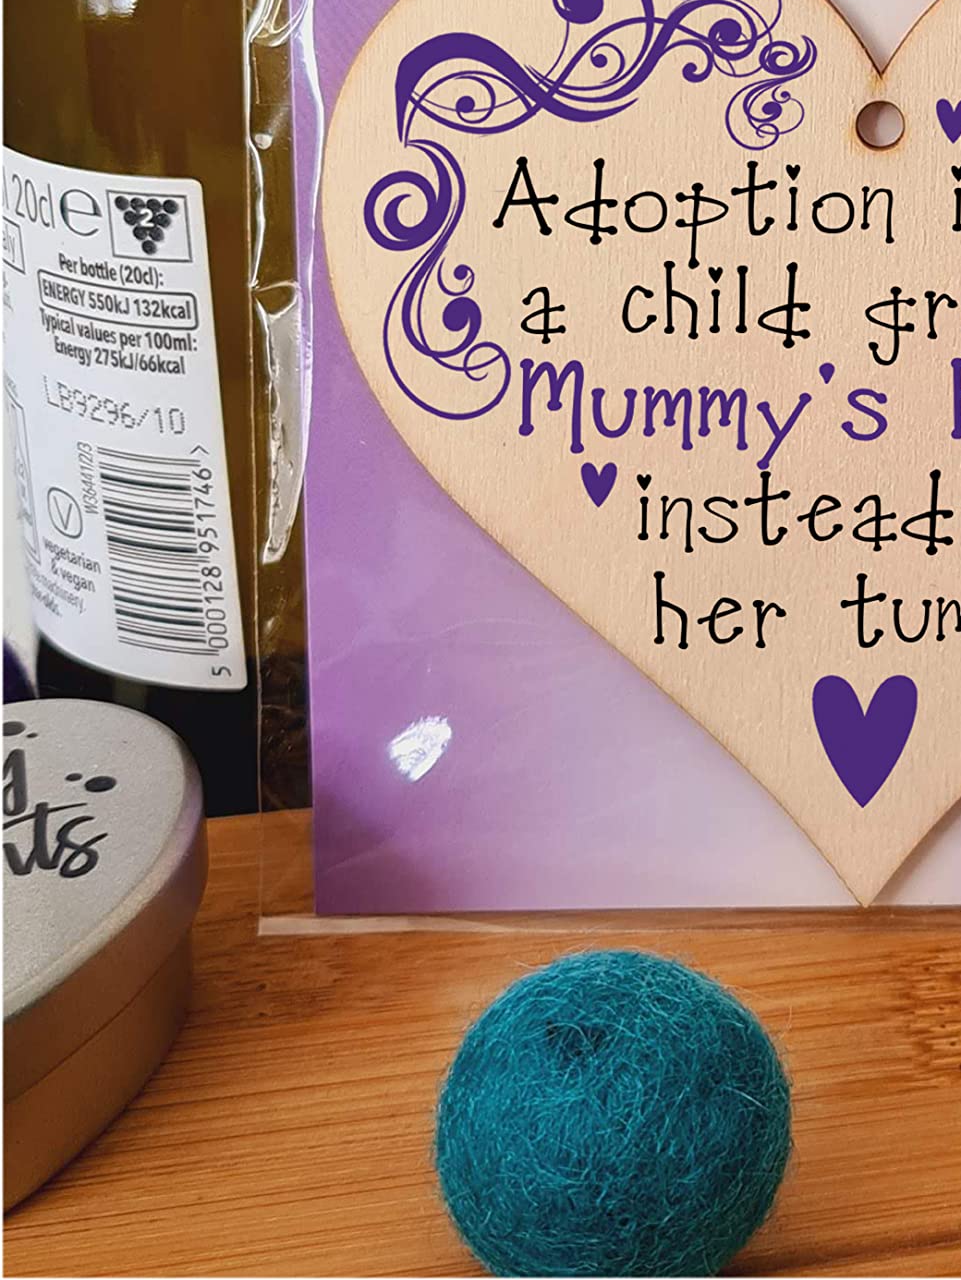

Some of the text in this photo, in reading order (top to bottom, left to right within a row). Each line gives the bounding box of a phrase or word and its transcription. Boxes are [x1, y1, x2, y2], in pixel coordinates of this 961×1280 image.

[12, 173, 55, 229] 20cl
[139, 209, 155, 227] 2
[492, 156, 895, 270] Adoption
[58, 252, 164, 289] Per bottle (20cl):
[42, 278, 86, 307] ENERGY
[88, 291, 130, 315] 550kJ
[133, 298, 191, 320] 132kcal
[520, 286, 566, 345] a
[621, 260, 811, 349] child
[39, 306, 198, 352] Typical values per 100ml:
[54, 335, 186, 375] Energy 275kJ/66kcal
[518, 357, 888, 471] Mummy's
[636, 469, 954, 556] instead
[44, 537, 101, 574] vegetarian
[60, 567, 96, 593] vegan
[194, 467, 232, 678] 5 000128 951746
[653, 570, 787, 650] her
